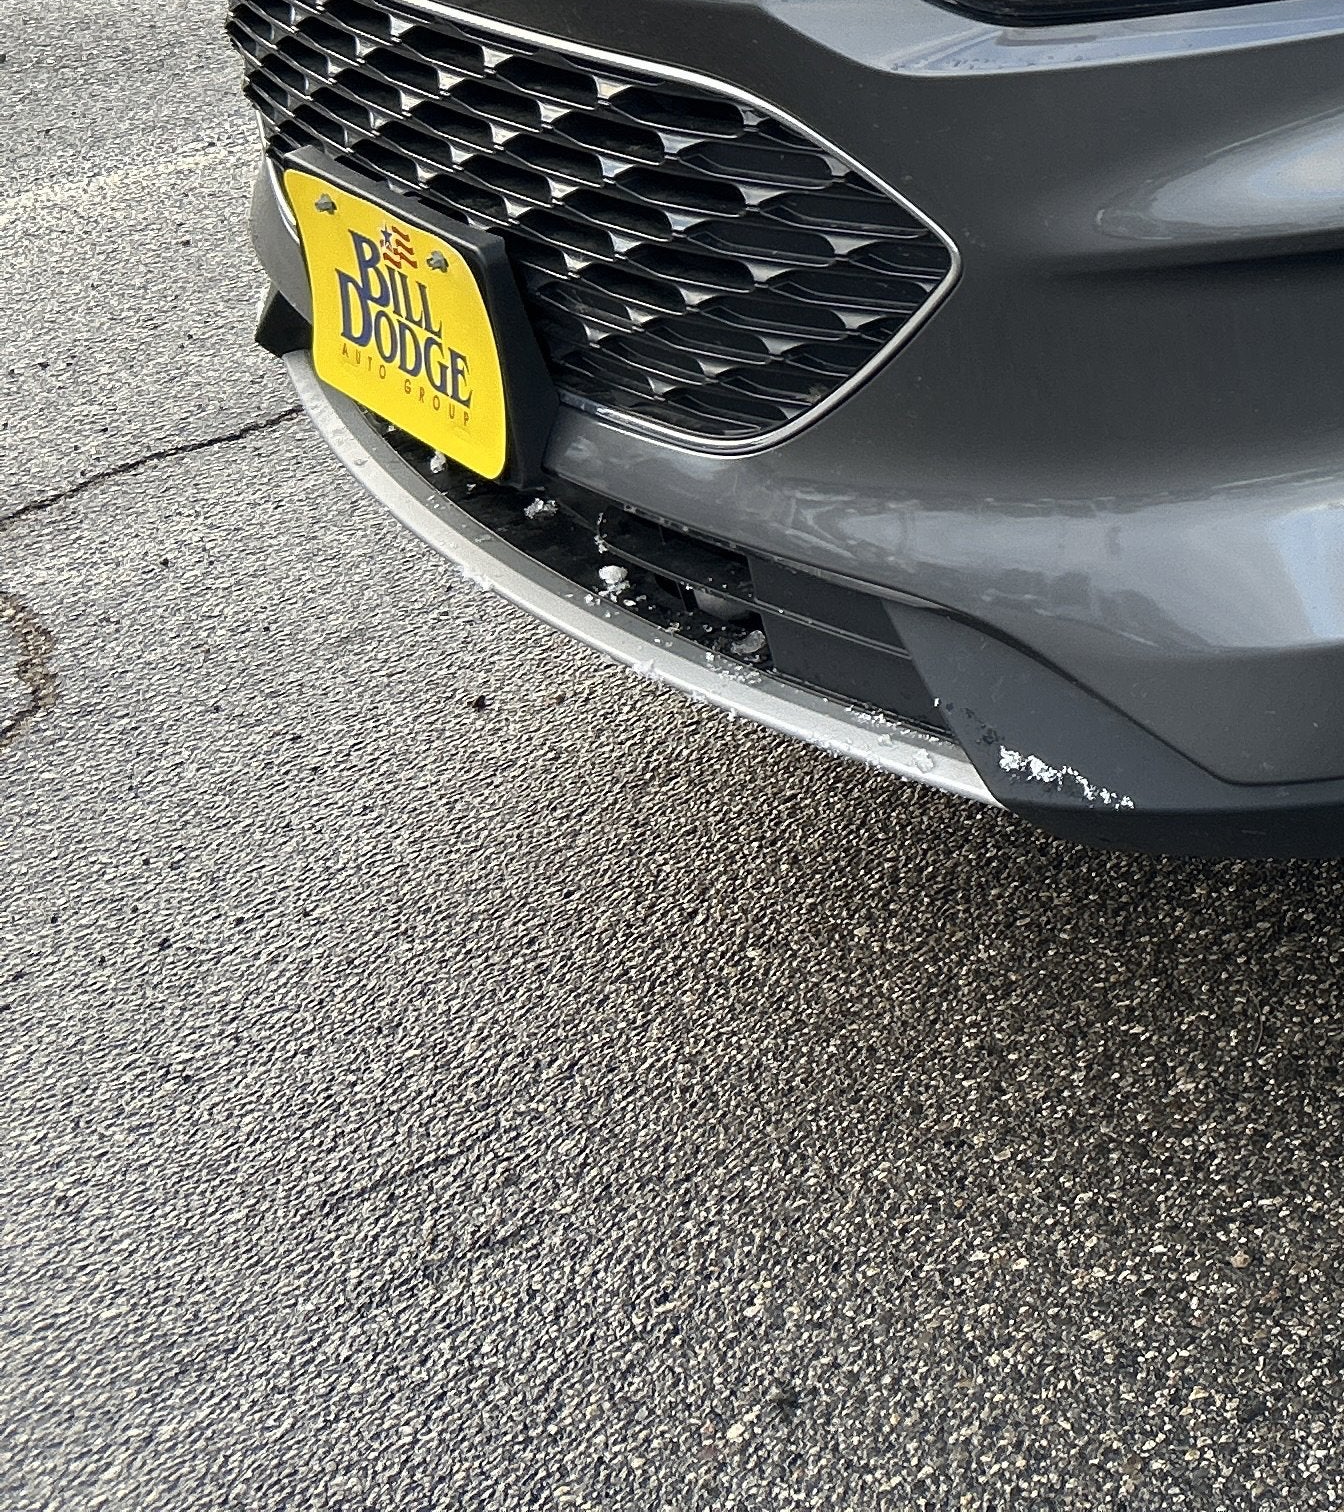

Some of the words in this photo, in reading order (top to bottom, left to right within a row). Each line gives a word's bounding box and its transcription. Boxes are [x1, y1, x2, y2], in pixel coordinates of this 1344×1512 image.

[335, 268, 474, 409] DODGE
[347, 229, 443, 339] BILL
[341, 342, 388, 381] AUTO
[403, 379, 472, 427] GROUP
